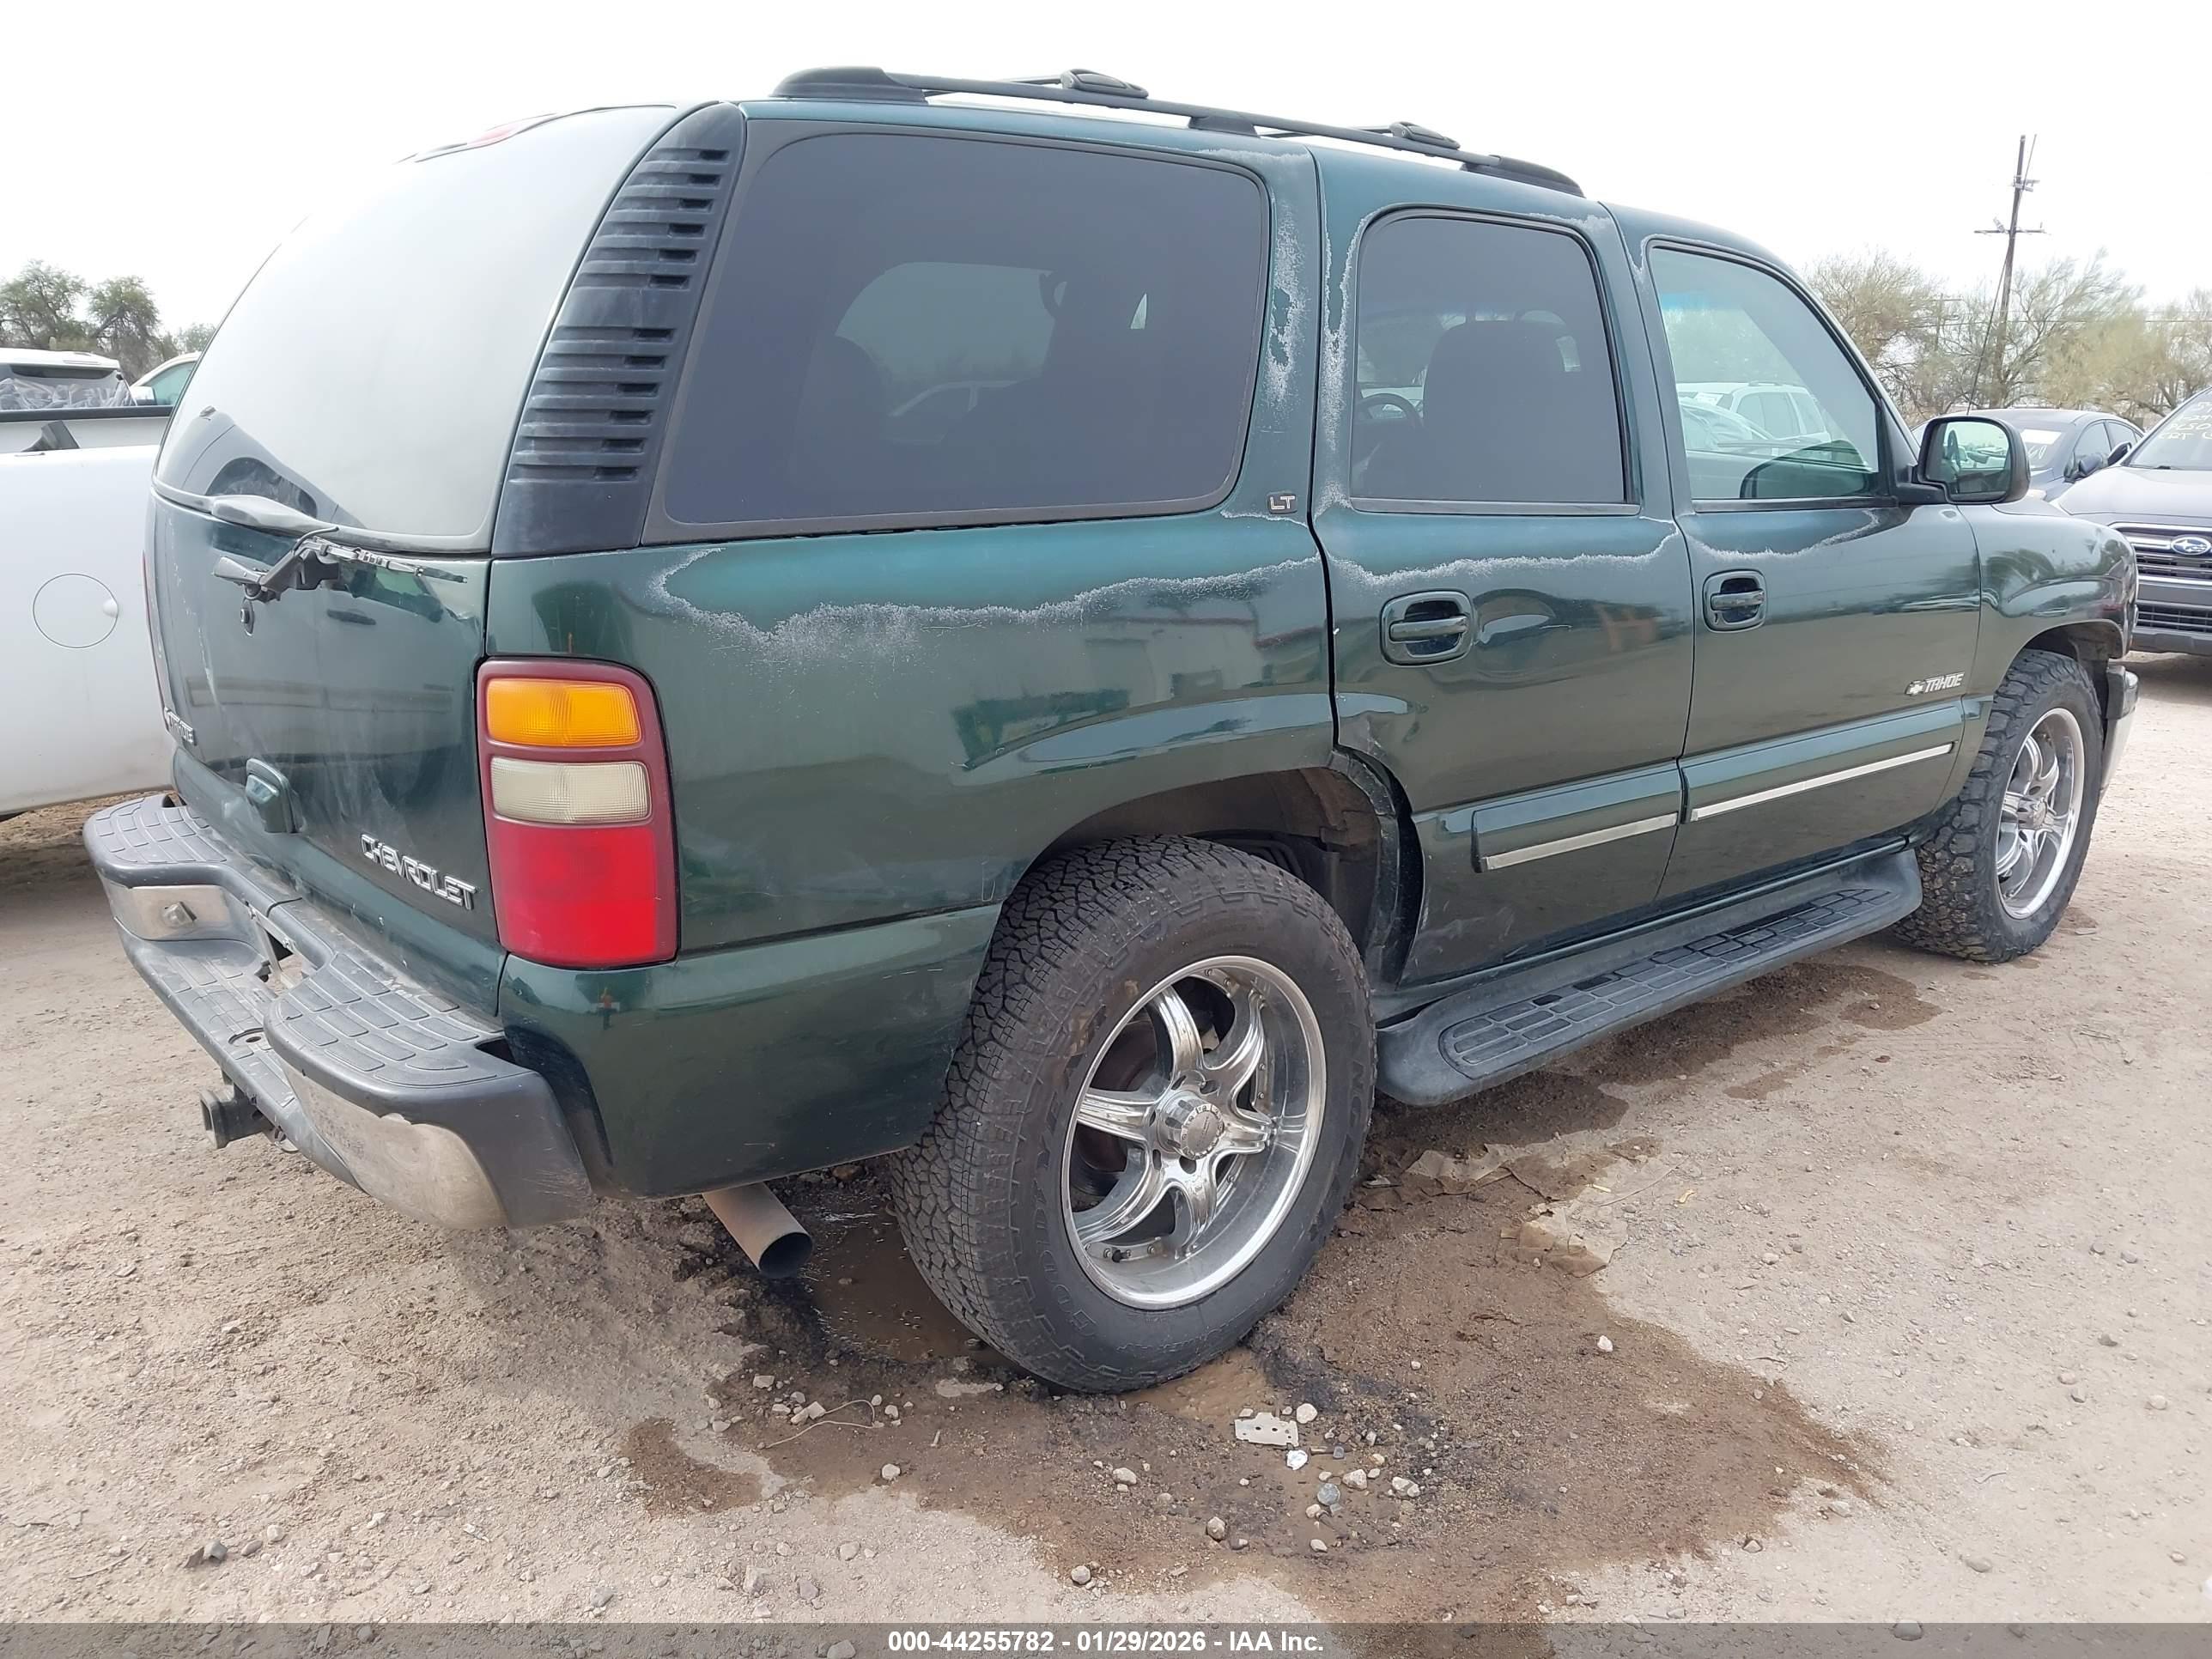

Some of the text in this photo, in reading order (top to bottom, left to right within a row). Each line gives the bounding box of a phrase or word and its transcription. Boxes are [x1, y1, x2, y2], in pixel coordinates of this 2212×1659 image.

[1269, 495, 1296, 510] LT
[1923, 672, 1965, 693] TAHOE
[361, 834, 476, 910] CHEVROLET
